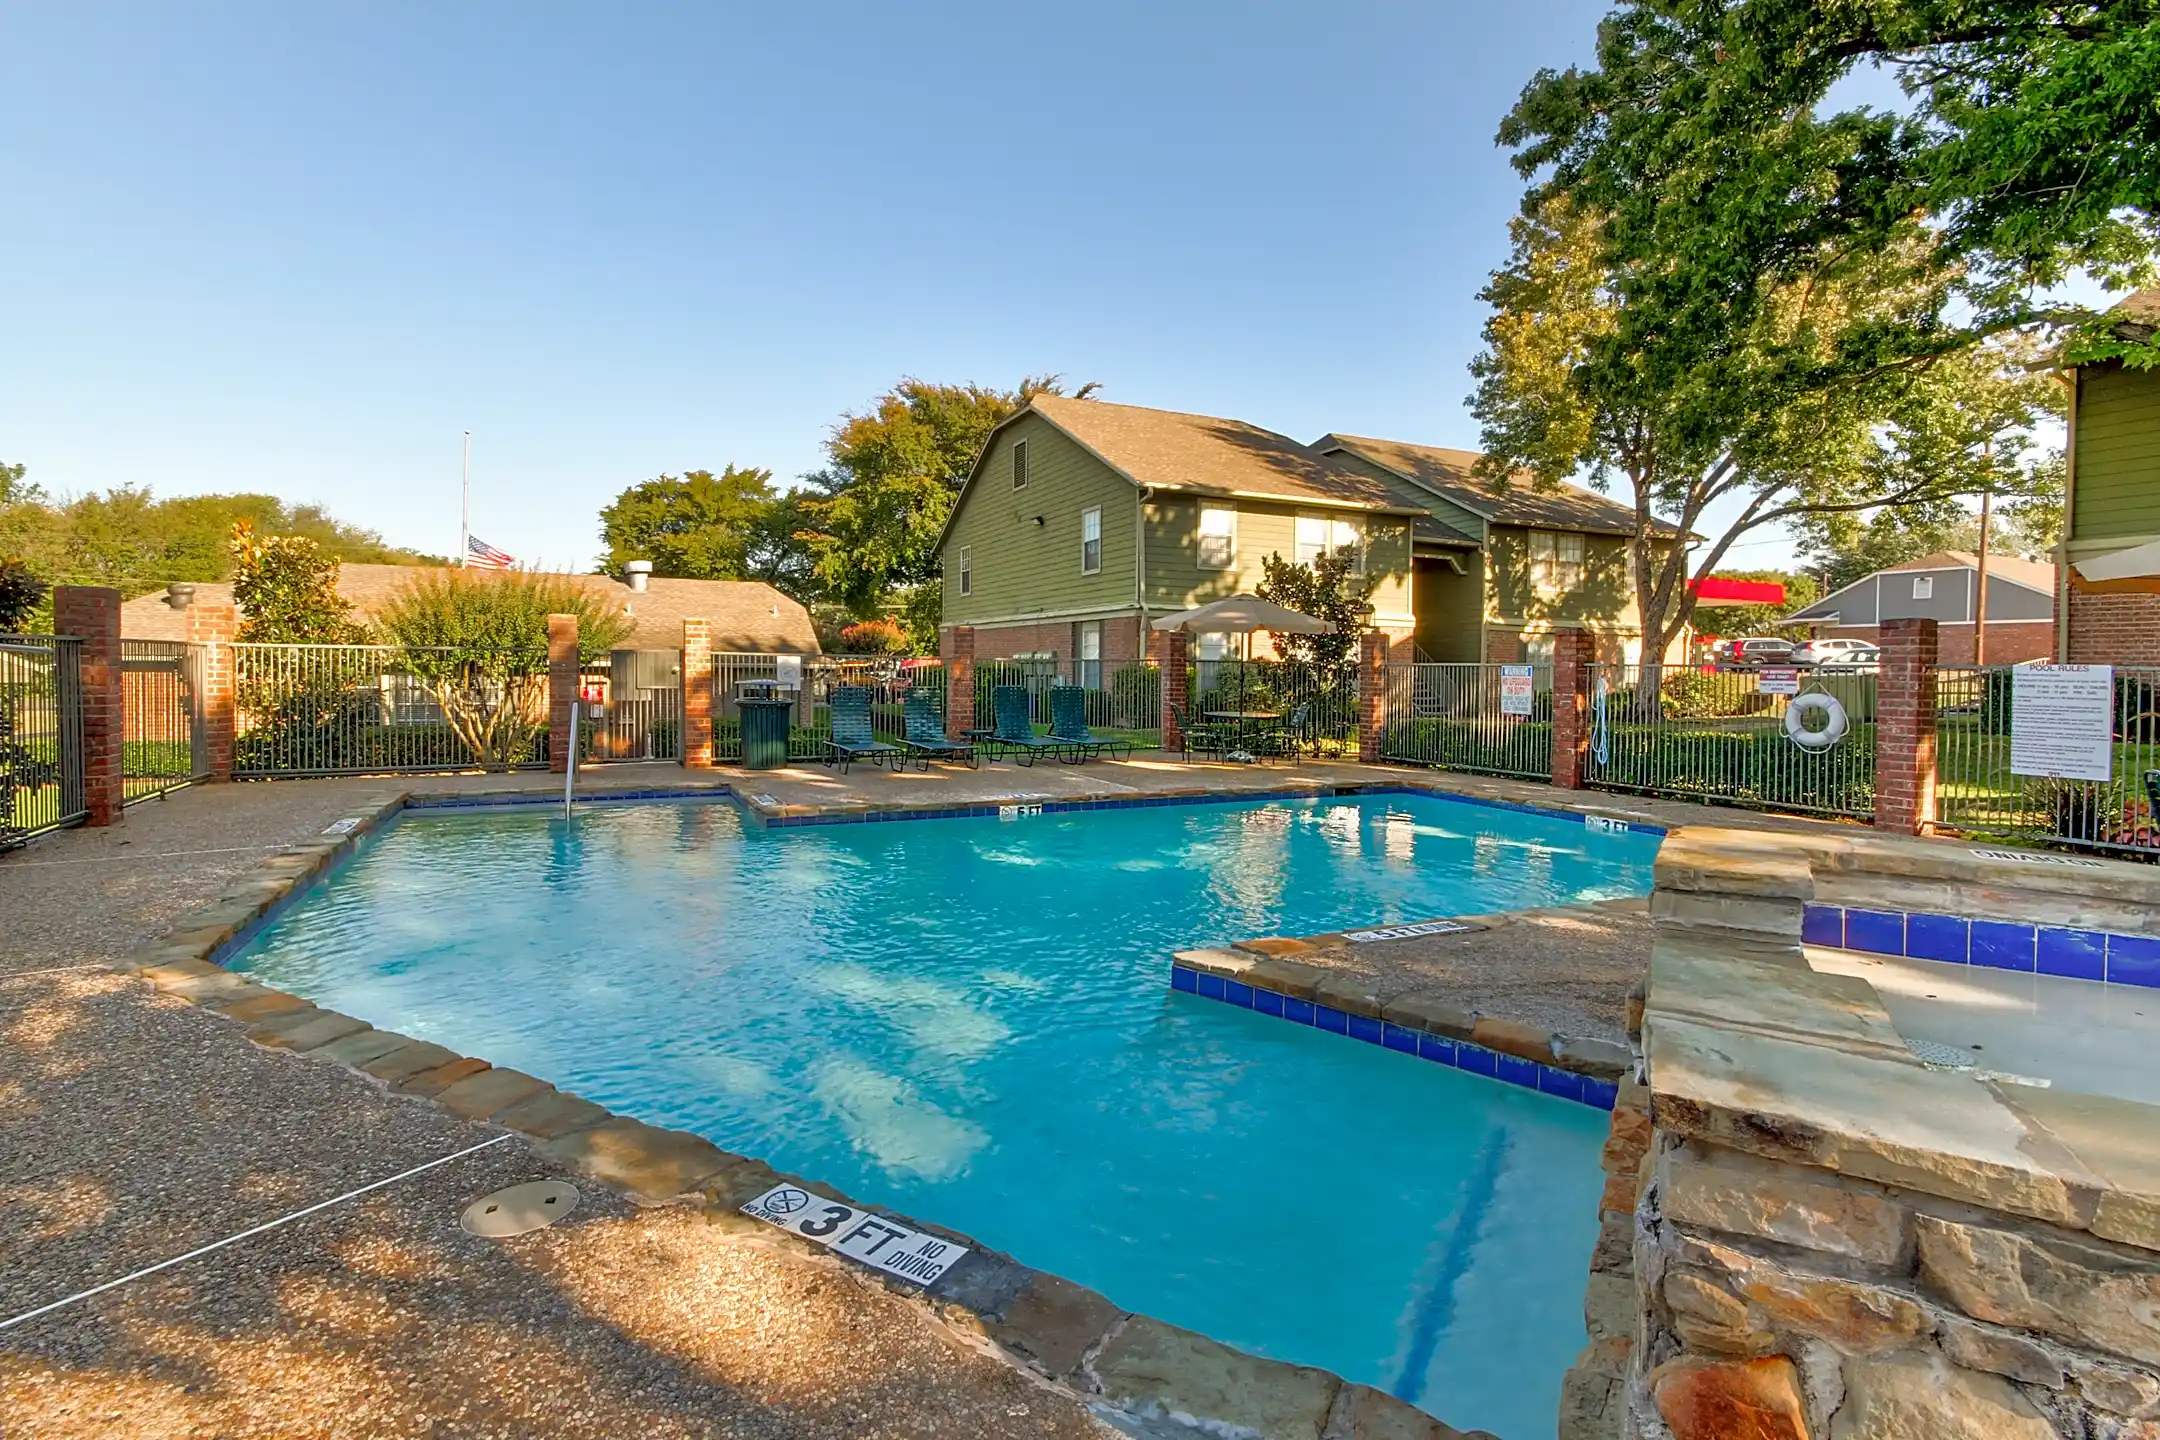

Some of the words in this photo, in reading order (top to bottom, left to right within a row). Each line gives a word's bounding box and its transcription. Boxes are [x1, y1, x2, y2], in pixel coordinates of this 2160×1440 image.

[1602, 819, 1610, 832] 3
[1614, 821, 1627, 832] FT
[1374, 929, 1396, 938] 5
[1393, 926, 1423, 936] FT
[742, 1203, 754, 1214] NO
[753, 1208, 788, 1226] DIVING
[799, 1206, 853, 1237] 3
[838, 1219, 909, 1256] FT
[915, 1240, 948, 1259] NO
[883, 1251, 944, 1281] DIVING
